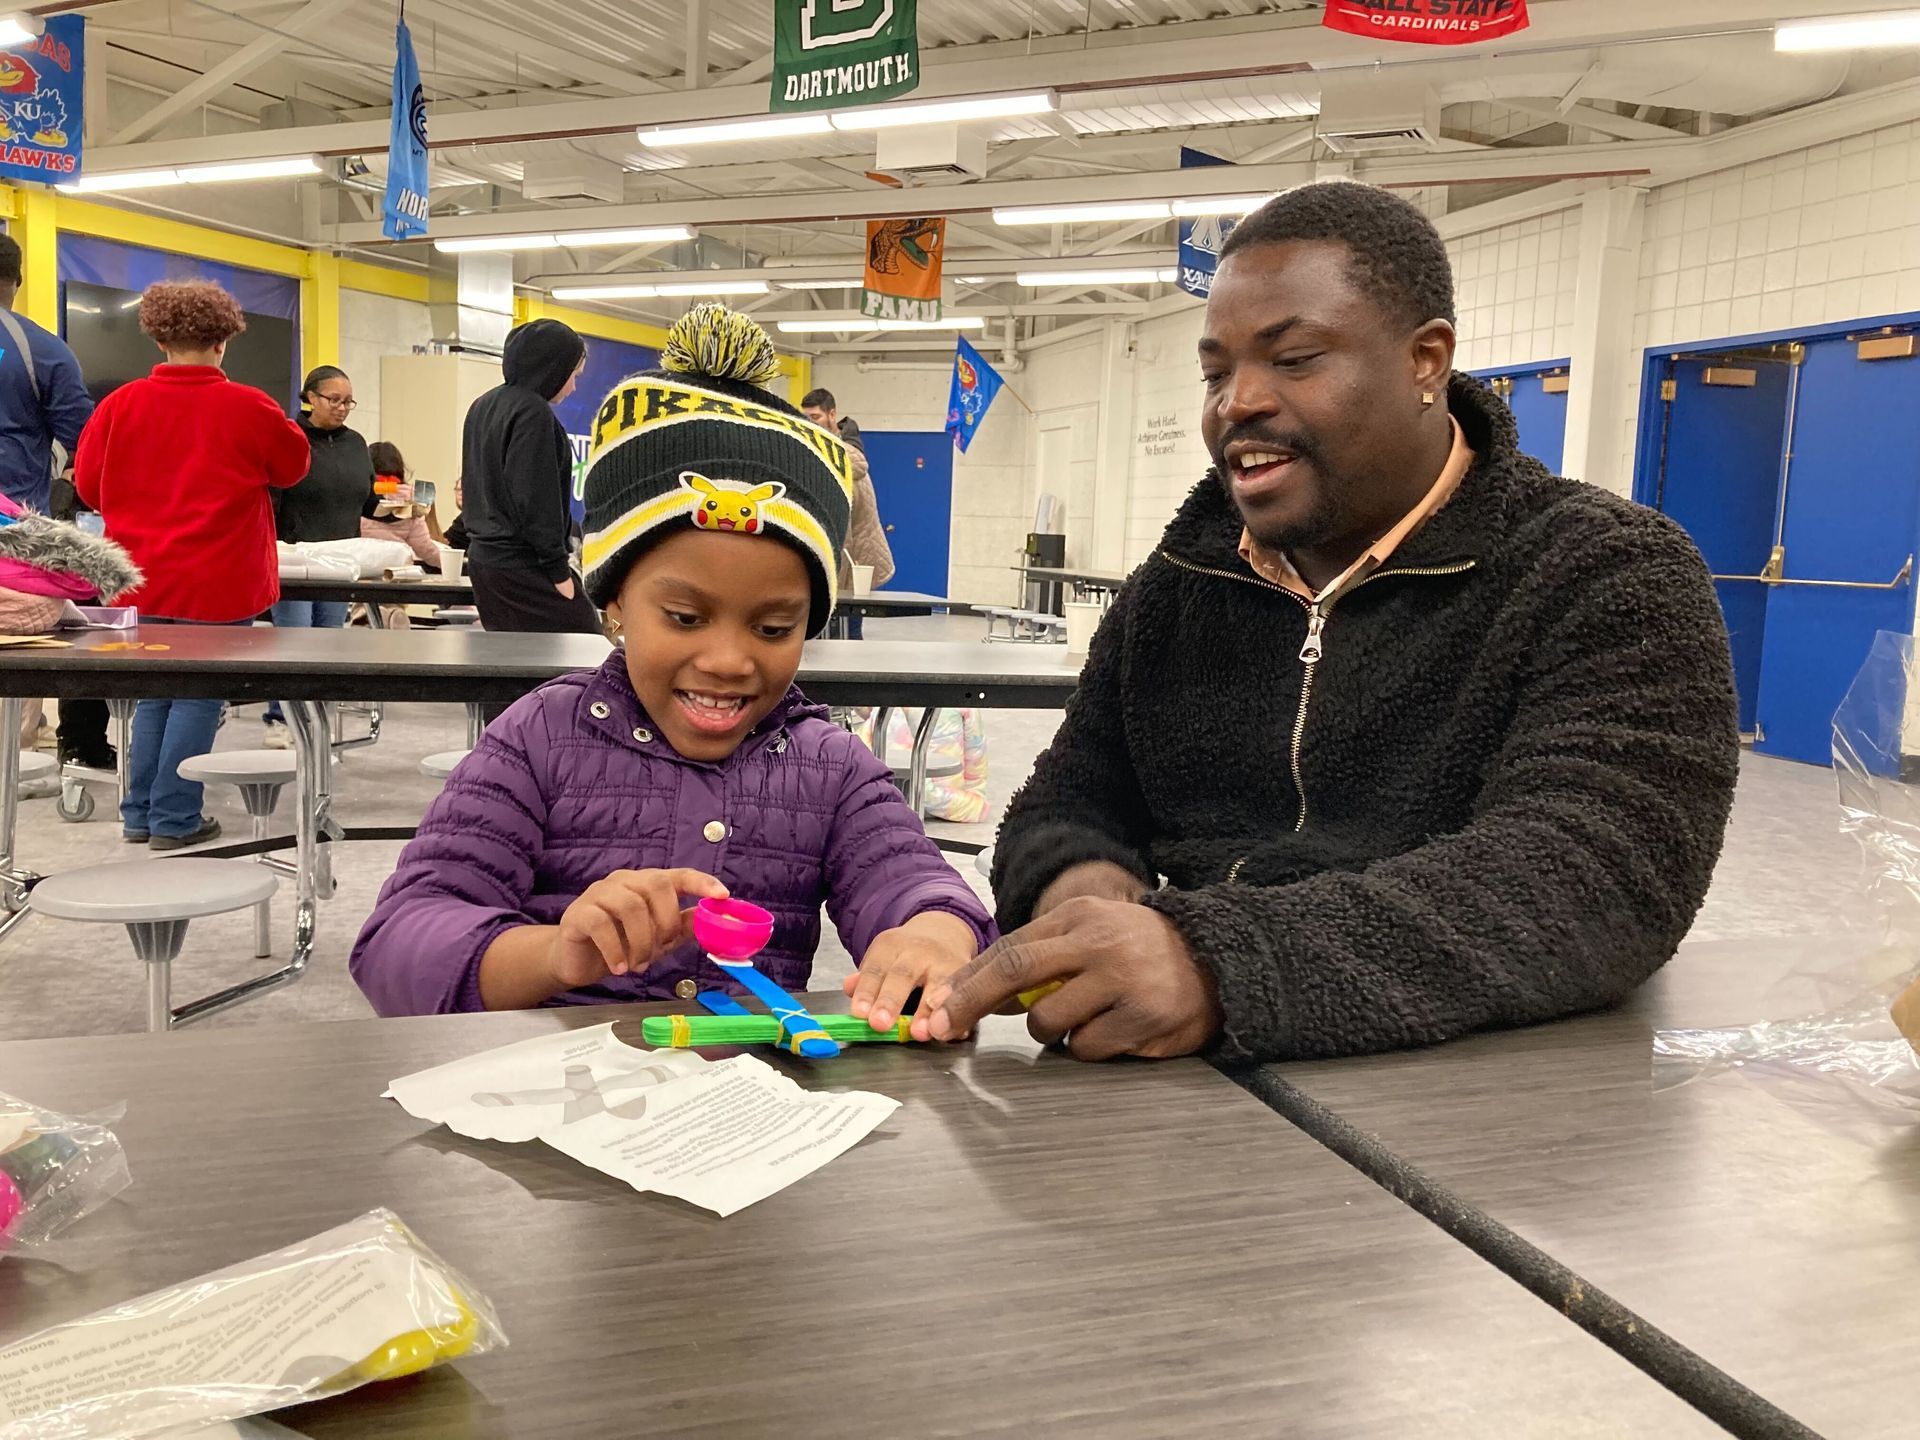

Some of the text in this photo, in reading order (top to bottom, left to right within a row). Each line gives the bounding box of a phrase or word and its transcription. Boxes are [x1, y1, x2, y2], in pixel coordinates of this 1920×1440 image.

[1343, 0, 1422, 13] ALL
[1371, 14, 1480, 31] CARDINALS
[784, 53, 909, 102] DARTMOUTH
[14, 101, 41, 120] KU
[865, 290, 938, 322] FAMU
[1147, 415, 1161, 428] Work
[1138, 431, 1158, 443] Achieve
[1145, 445, 1153, 456] No
[313, 1280, 386, 1329] egg bottom to
[42, 1355, 69, 1369] craft
[72, 1345, 106, 1360] sticks
[108, 1337, 131, 1349] and
[161, 1315, 198, 1333] rubber
[43, 1386, 64, 1397] are
[66, 1373, 105, 1391] bound
